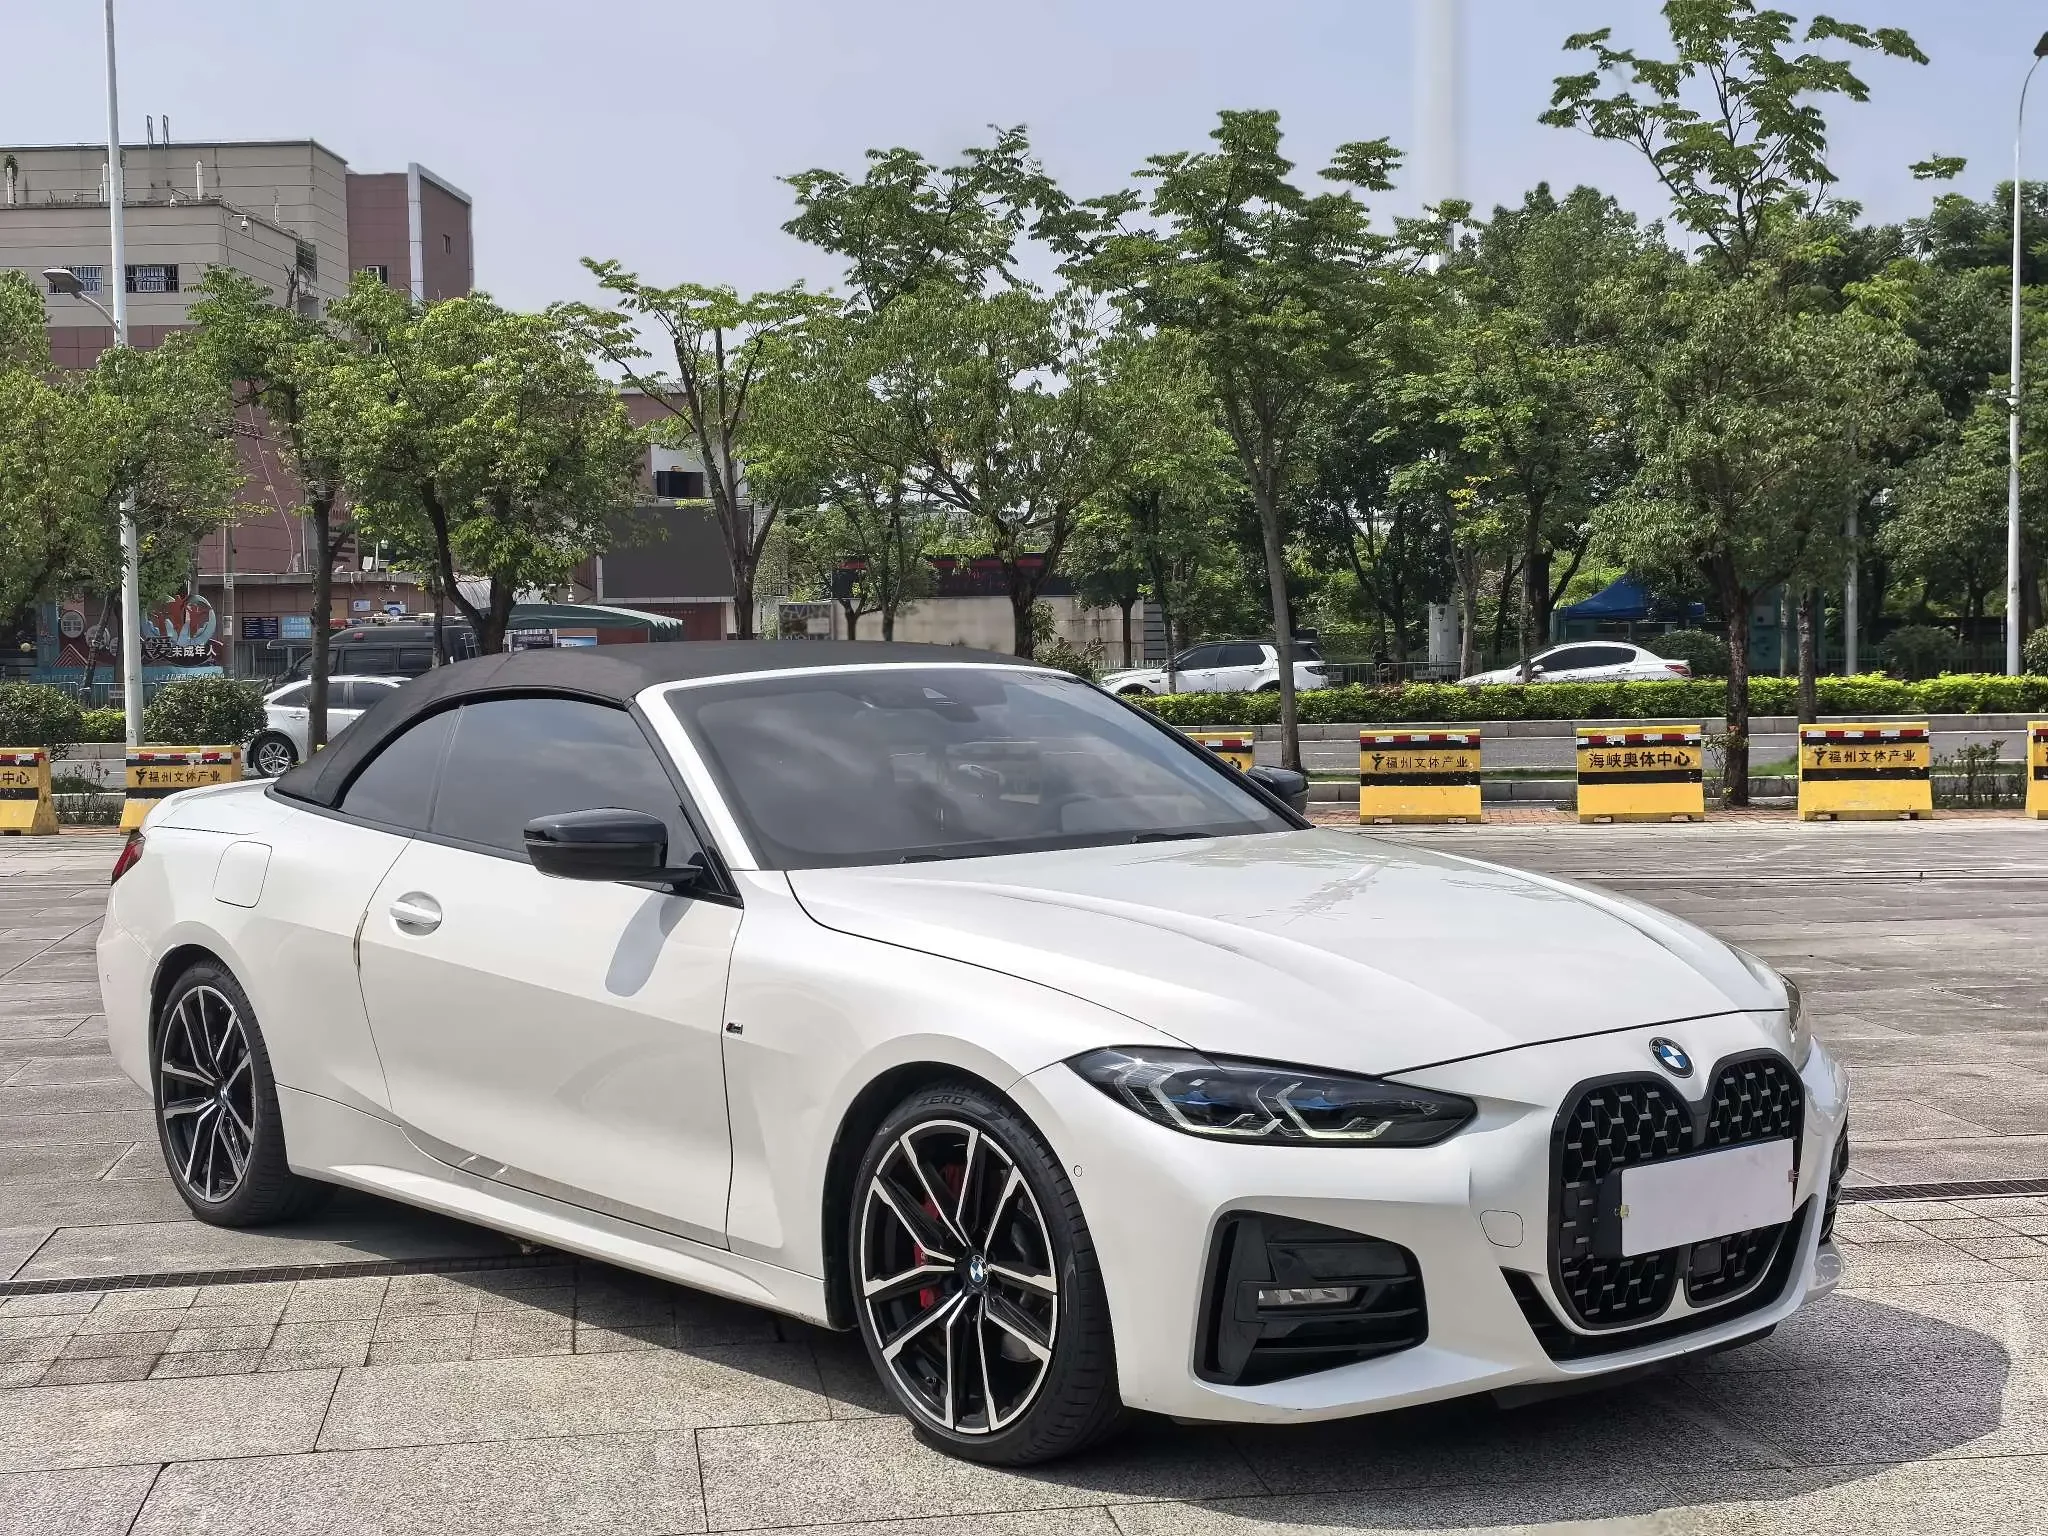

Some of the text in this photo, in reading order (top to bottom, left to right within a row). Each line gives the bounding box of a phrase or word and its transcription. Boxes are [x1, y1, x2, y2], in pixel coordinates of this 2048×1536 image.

[1385, 755, 1468, 768] 福州文体产业
[1588, 750, 1690, 768] 海峡奥体中心
[1829, 749, 1916, 762] 福州文体产业
[2, 770, 30, 785] 中心
[148, 770, 221, 783] 福州文体产业
[918, 1094, 967, 1108] ZERO
